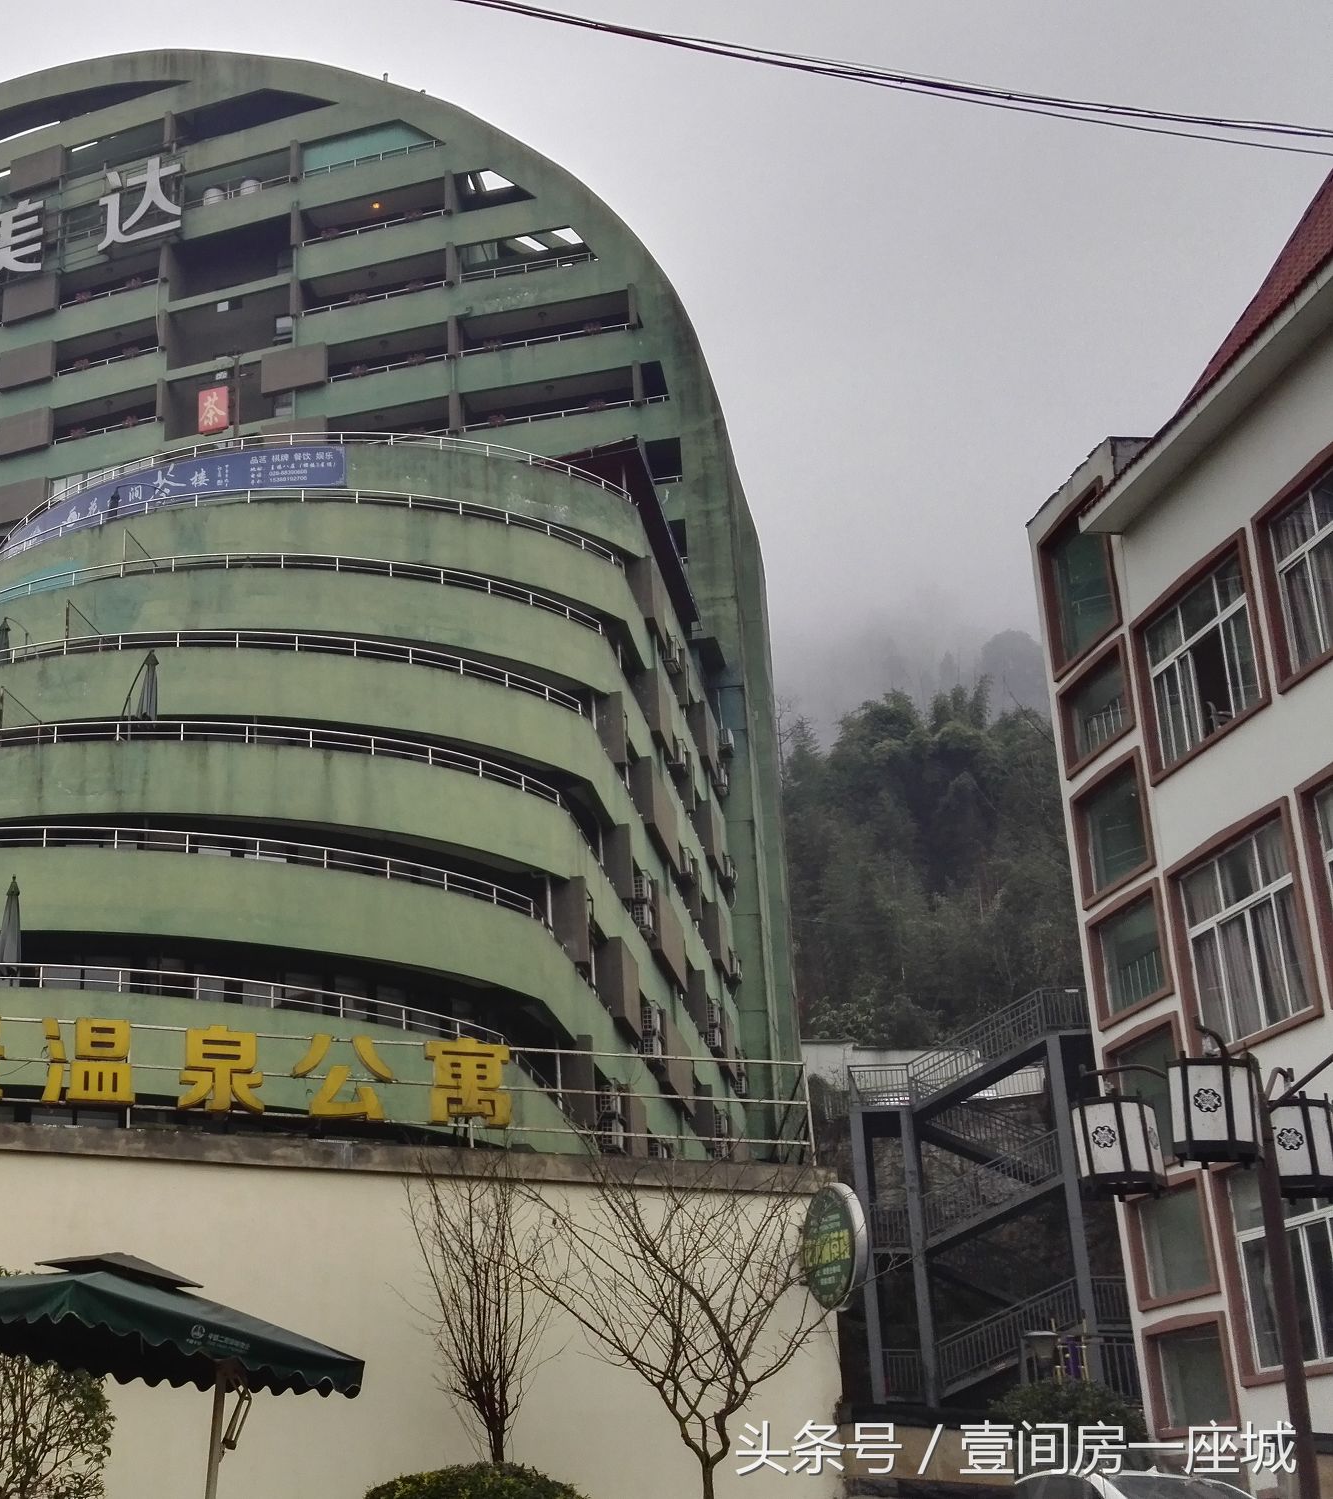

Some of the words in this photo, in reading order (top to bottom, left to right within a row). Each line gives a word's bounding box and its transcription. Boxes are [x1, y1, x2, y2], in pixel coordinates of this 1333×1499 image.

[200, 391, 226, 426] 茶
[272, 453, 289, 462] 棋牌
[294, 452, 311, 461] 餐饮
[316, 451, 333, 460] 娱乐
